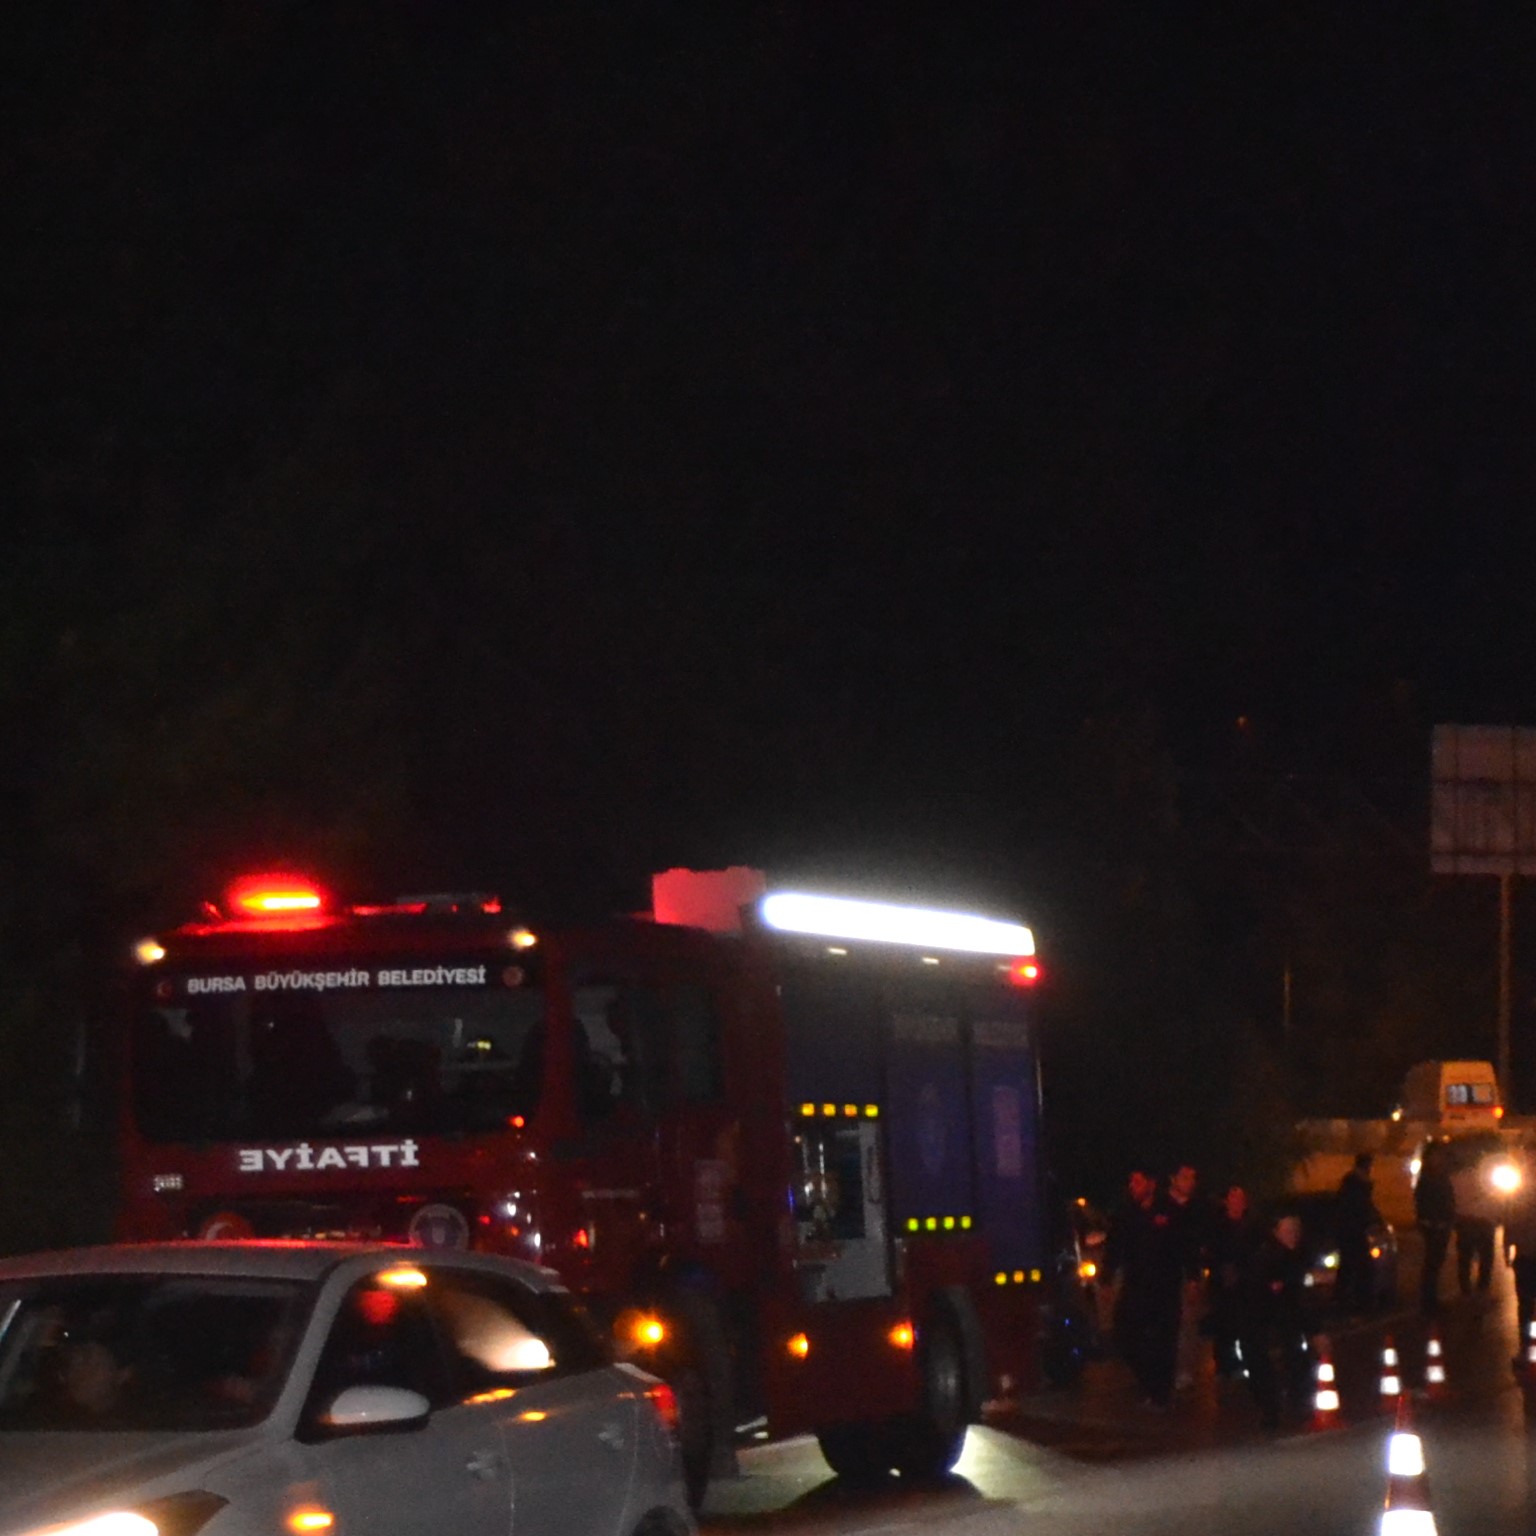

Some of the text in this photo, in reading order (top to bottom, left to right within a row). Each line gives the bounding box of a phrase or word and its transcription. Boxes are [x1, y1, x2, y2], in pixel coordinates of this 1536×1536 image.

[187, 964, 487, 994] BURSA BÜYÜKŞEHİR BELEDİYESİ
